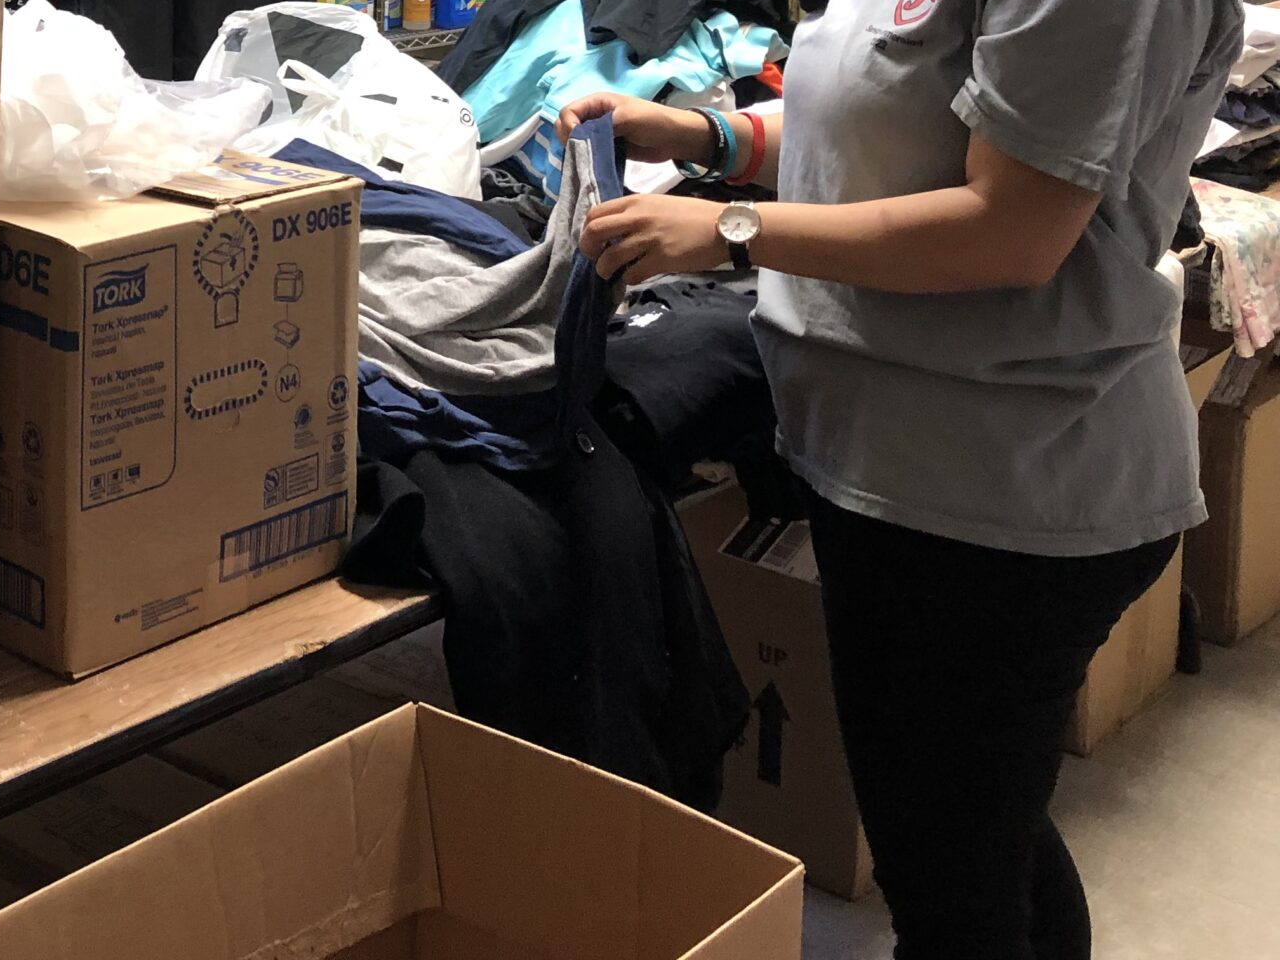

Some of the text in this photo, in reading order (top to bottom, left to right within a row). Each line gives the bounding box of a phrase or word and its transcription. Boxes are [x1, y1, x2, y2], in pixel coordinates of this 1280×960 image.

[272, 201, 352, 242] DX 906E
[94, 279, 143, 308] TORK
[92, 318, 114, 334] Tork
[91, 374, 113, 387] Tork
[279, 374, 298, 393] N4
[90, 411, 112, 425] Tork
[758, 641, 788, 667] UP
